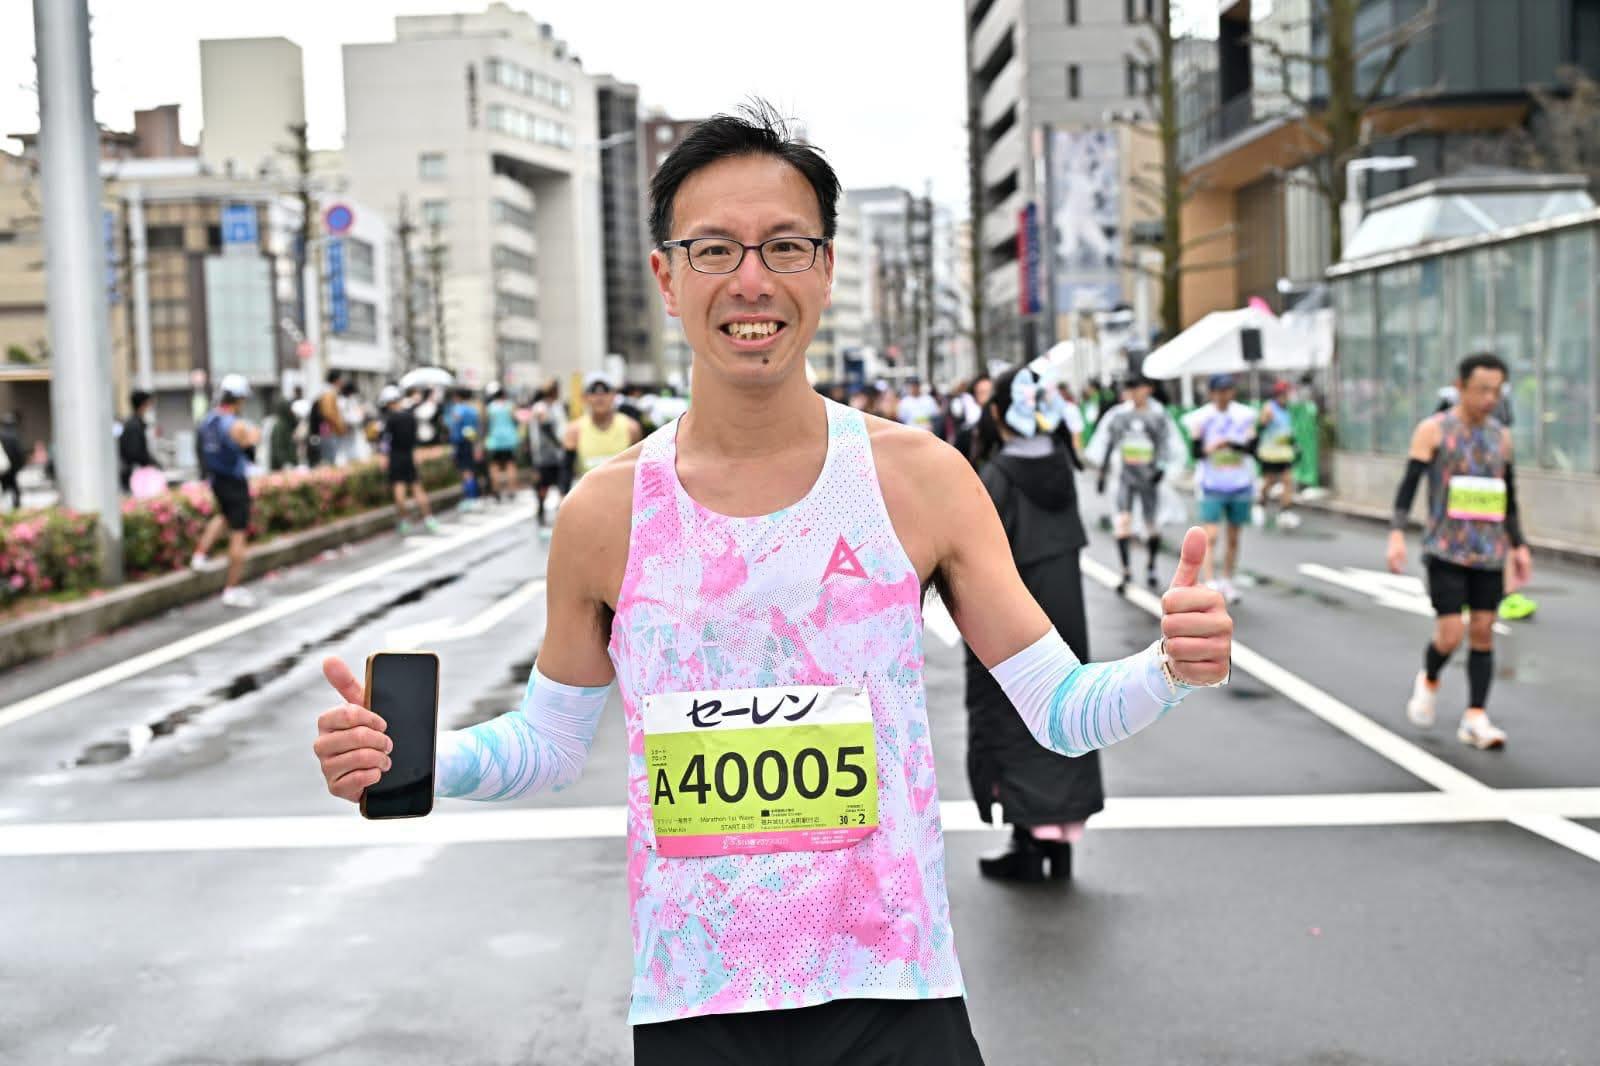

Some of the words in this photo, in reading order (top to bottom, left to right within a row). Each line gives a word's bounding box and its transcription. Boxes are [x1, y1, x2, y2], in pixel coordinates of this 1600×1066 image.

[686, 692, 819, 728] セーレン
[654, 768, 675, 805] A
[678, 746, 868, 805] 40005
[839, 815, 849, 825] 30
[858, 813, 866, 824] 2
